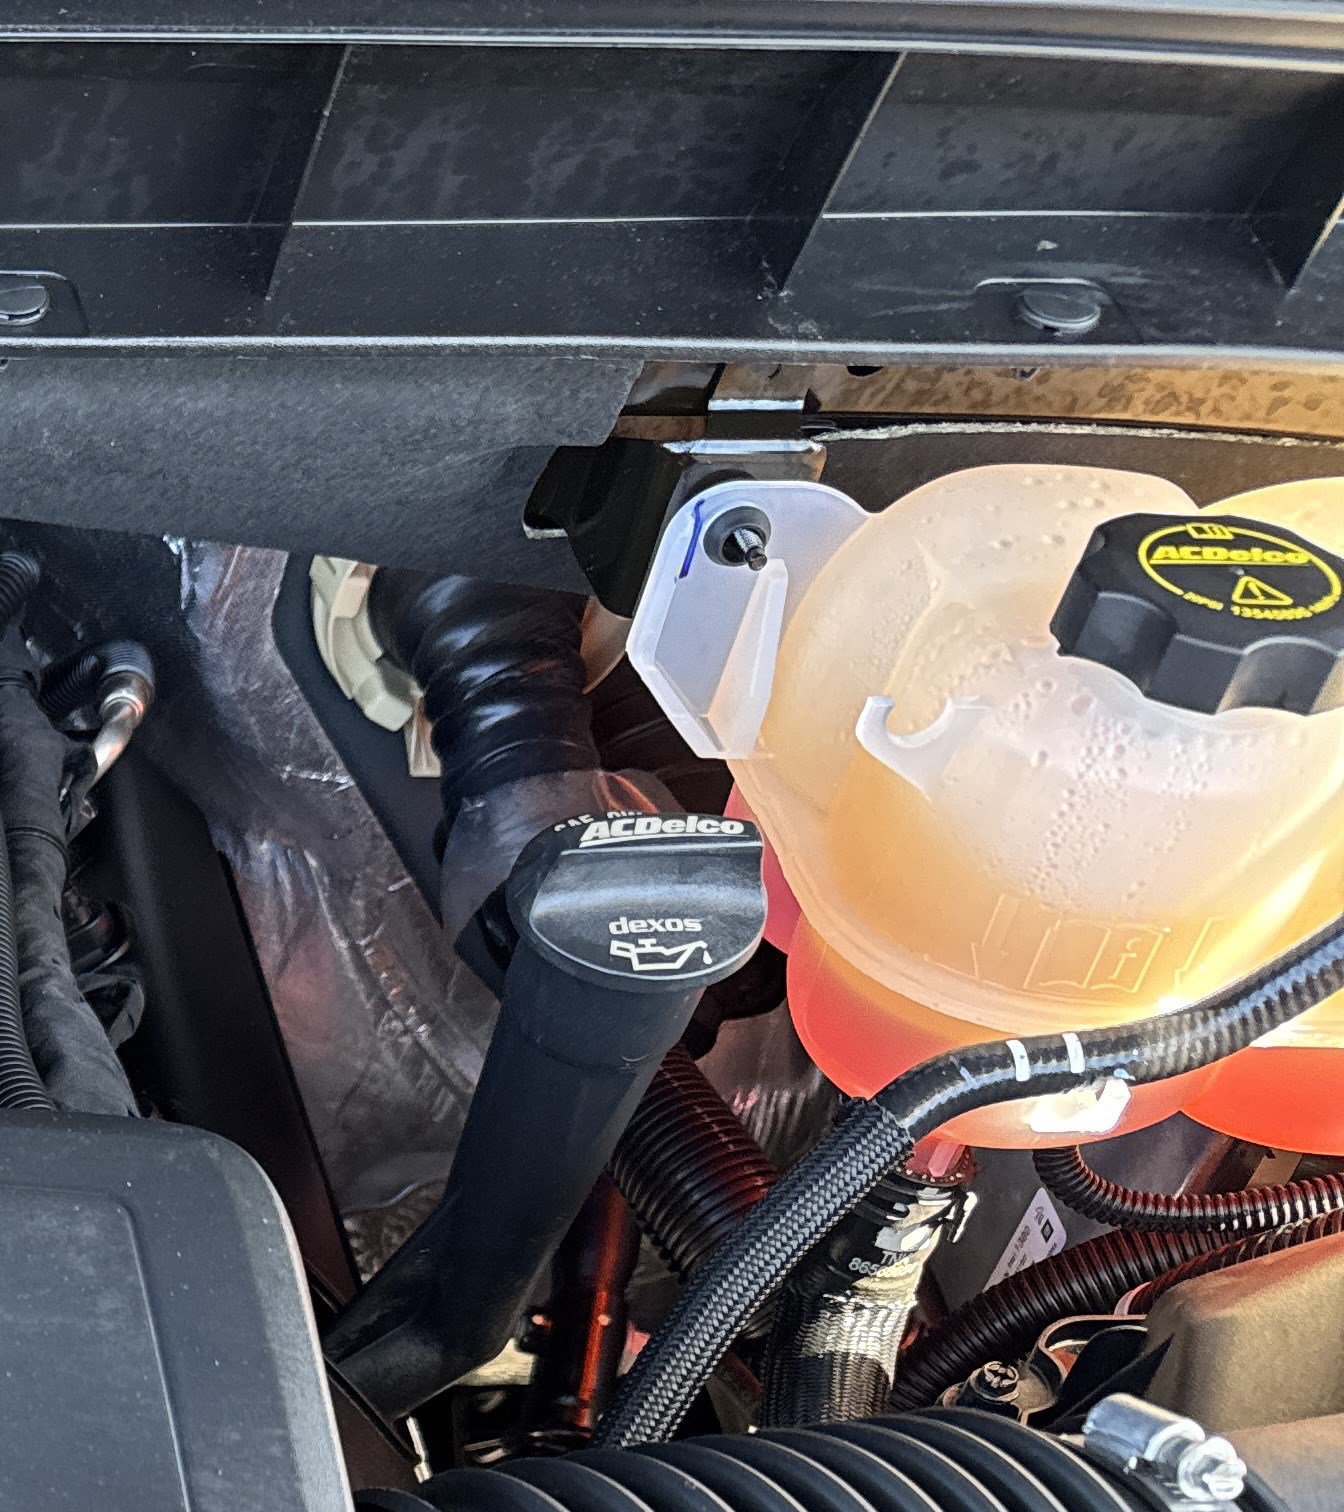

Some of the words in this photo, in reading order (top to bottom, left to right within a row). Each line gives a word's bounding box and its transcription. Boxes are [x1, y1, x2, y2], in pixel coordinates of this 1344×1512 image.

[1150, 545, 1311, 564] ACDelco
[579, 815, 745, 842] ACDelco
[608, 916, 703, 935] dexos
